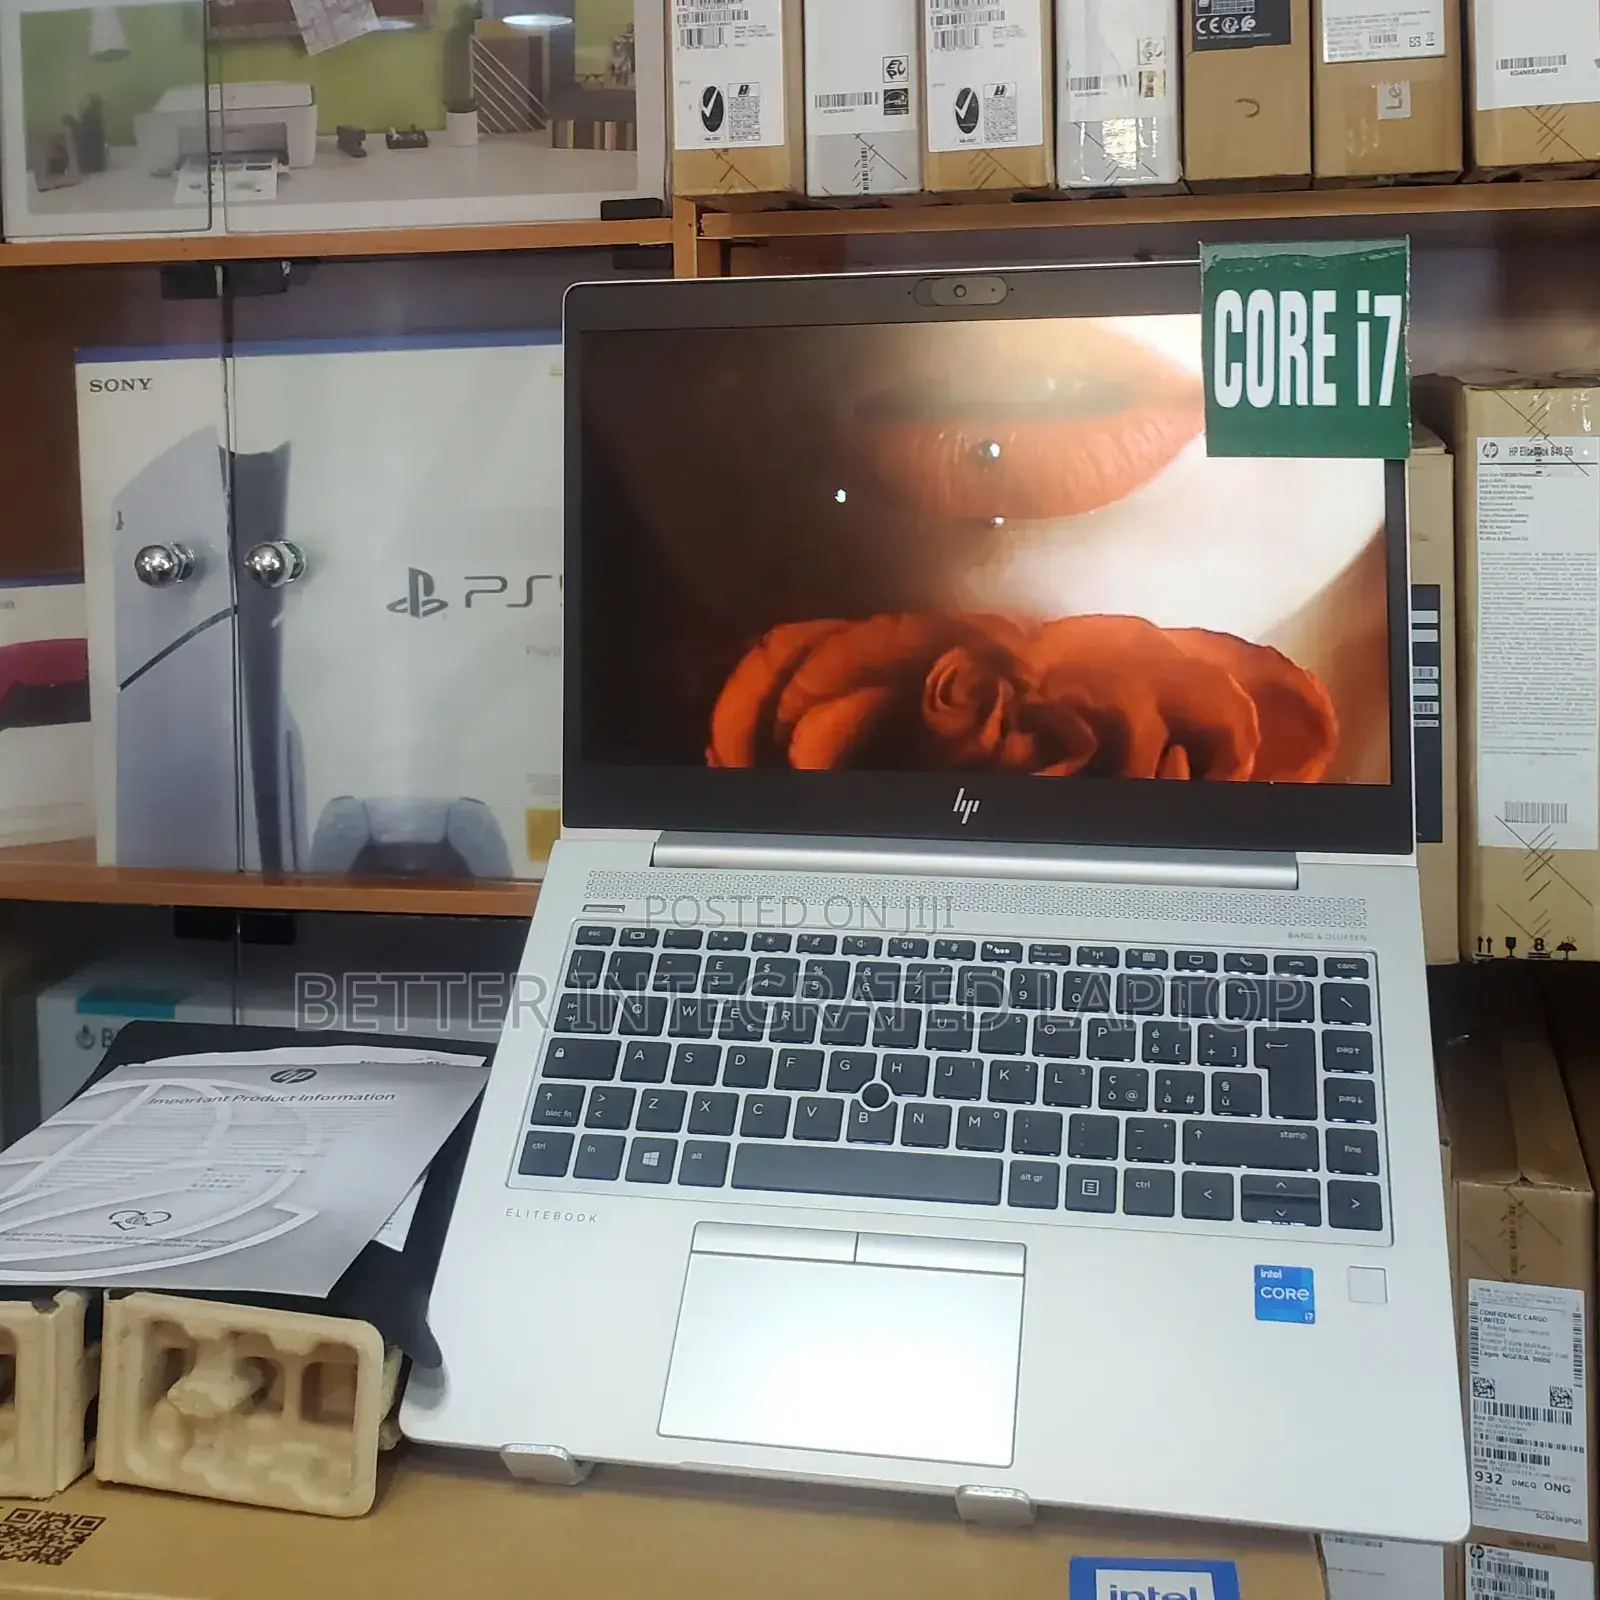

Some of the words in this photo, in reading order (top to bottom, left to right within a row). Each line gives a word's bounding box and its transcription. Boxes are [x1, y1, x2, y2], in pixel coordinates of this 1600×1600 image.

[1214, 289, 1337, 408] CORE
[1357, 290, 1402, 406] i7
[89, 378, 153, 392] SONY
[1509, 447, 1518, 456] HP
[464, 574, 563, 608] PS
[953, 787, 980, 824] hp
[1288, 932, 1314, 940] BANG
[763, 963, 771, 974] $
[814, 966, 823, 975] %
[662, 975, 670, 983] 2
[711, 976, 719, 985] 3
[761, 979, 769, 987] 4
[811, 981, 819, 991] 5
[862, 983, 870, 992] 6
[914, 985, 922, 994] 7
[966, 987, 975, 997] 8
[1019, 991, 1028, 1000] 9
[632, 1003, 643, 1016] Q
[682, 1005, 698, 1017] W
[730, 1008, 740, 1019] E
[781, 1010, 791, 1021] R
[832, 1012, 841, 1023] T
[885, 1015, 895, 1026] Y
[937, 1018, 947, 1028] U
[1097, 1026, 1108, 1037] P
[633, 1050, 645, 1061] A
[684, 1052, 694, 1063] S
[734, 1055, 746, 1066] D
[786, 1057, 797, 1068] F
[839, 1060, 851, 1071] G
[891, 1063, 903, 1074] H
[944, 1066, 953, 1077] J
[999, 1069, 1010, 1081] K
[1054, 1073, 1063, 1084] L
[149, 1095, 230, 1105] Important
[232, 1094, 296, 1103] Product
[299, 1092, 396, 1101] Information
[1125, 1089, 1139, 1101] @
[648, 1098, 658, 1109] Z
[700, 1100, 711, 1112] X
[564, 1109, 572, 1118] fn
[752, 1104, 764, 1115] C
[806, 1106, 818, 1118] V
[858, 1112, 869, 1123] B
[913, 1113, 925, 1124] N
[968, 1116, 981, 1128] M
[1279, 1130, 1308, 1140] stamp
[532, 1142, 547, 1150] ctrl
[587, 1145, 596, 1153] fn
[1344, 1145, 1362, 1154] fine
[691, 1152, 703, 1160] alt
[1020, 1173, 1032, 1182] alt
[1033, 1174, 1043, 1183] gr
[1135, 1180, 1151, 1188] ctrl
[505, 1208, 597, 1223] ELITEBOOK
[1260, 1268, 1283, 1280] intel
[1479, 1309, 1522, 1320] CONFIDENCE
[1523, 1314, 1548, 1323] CARGO
[1479, 1317, 1506, 1325] LIMITED
[1502, 1352, 1530, 1361] NIGERIA
[1474, 1470, 1503, 1485] 932
[1544, 1482, 1572, 1494] ONG
